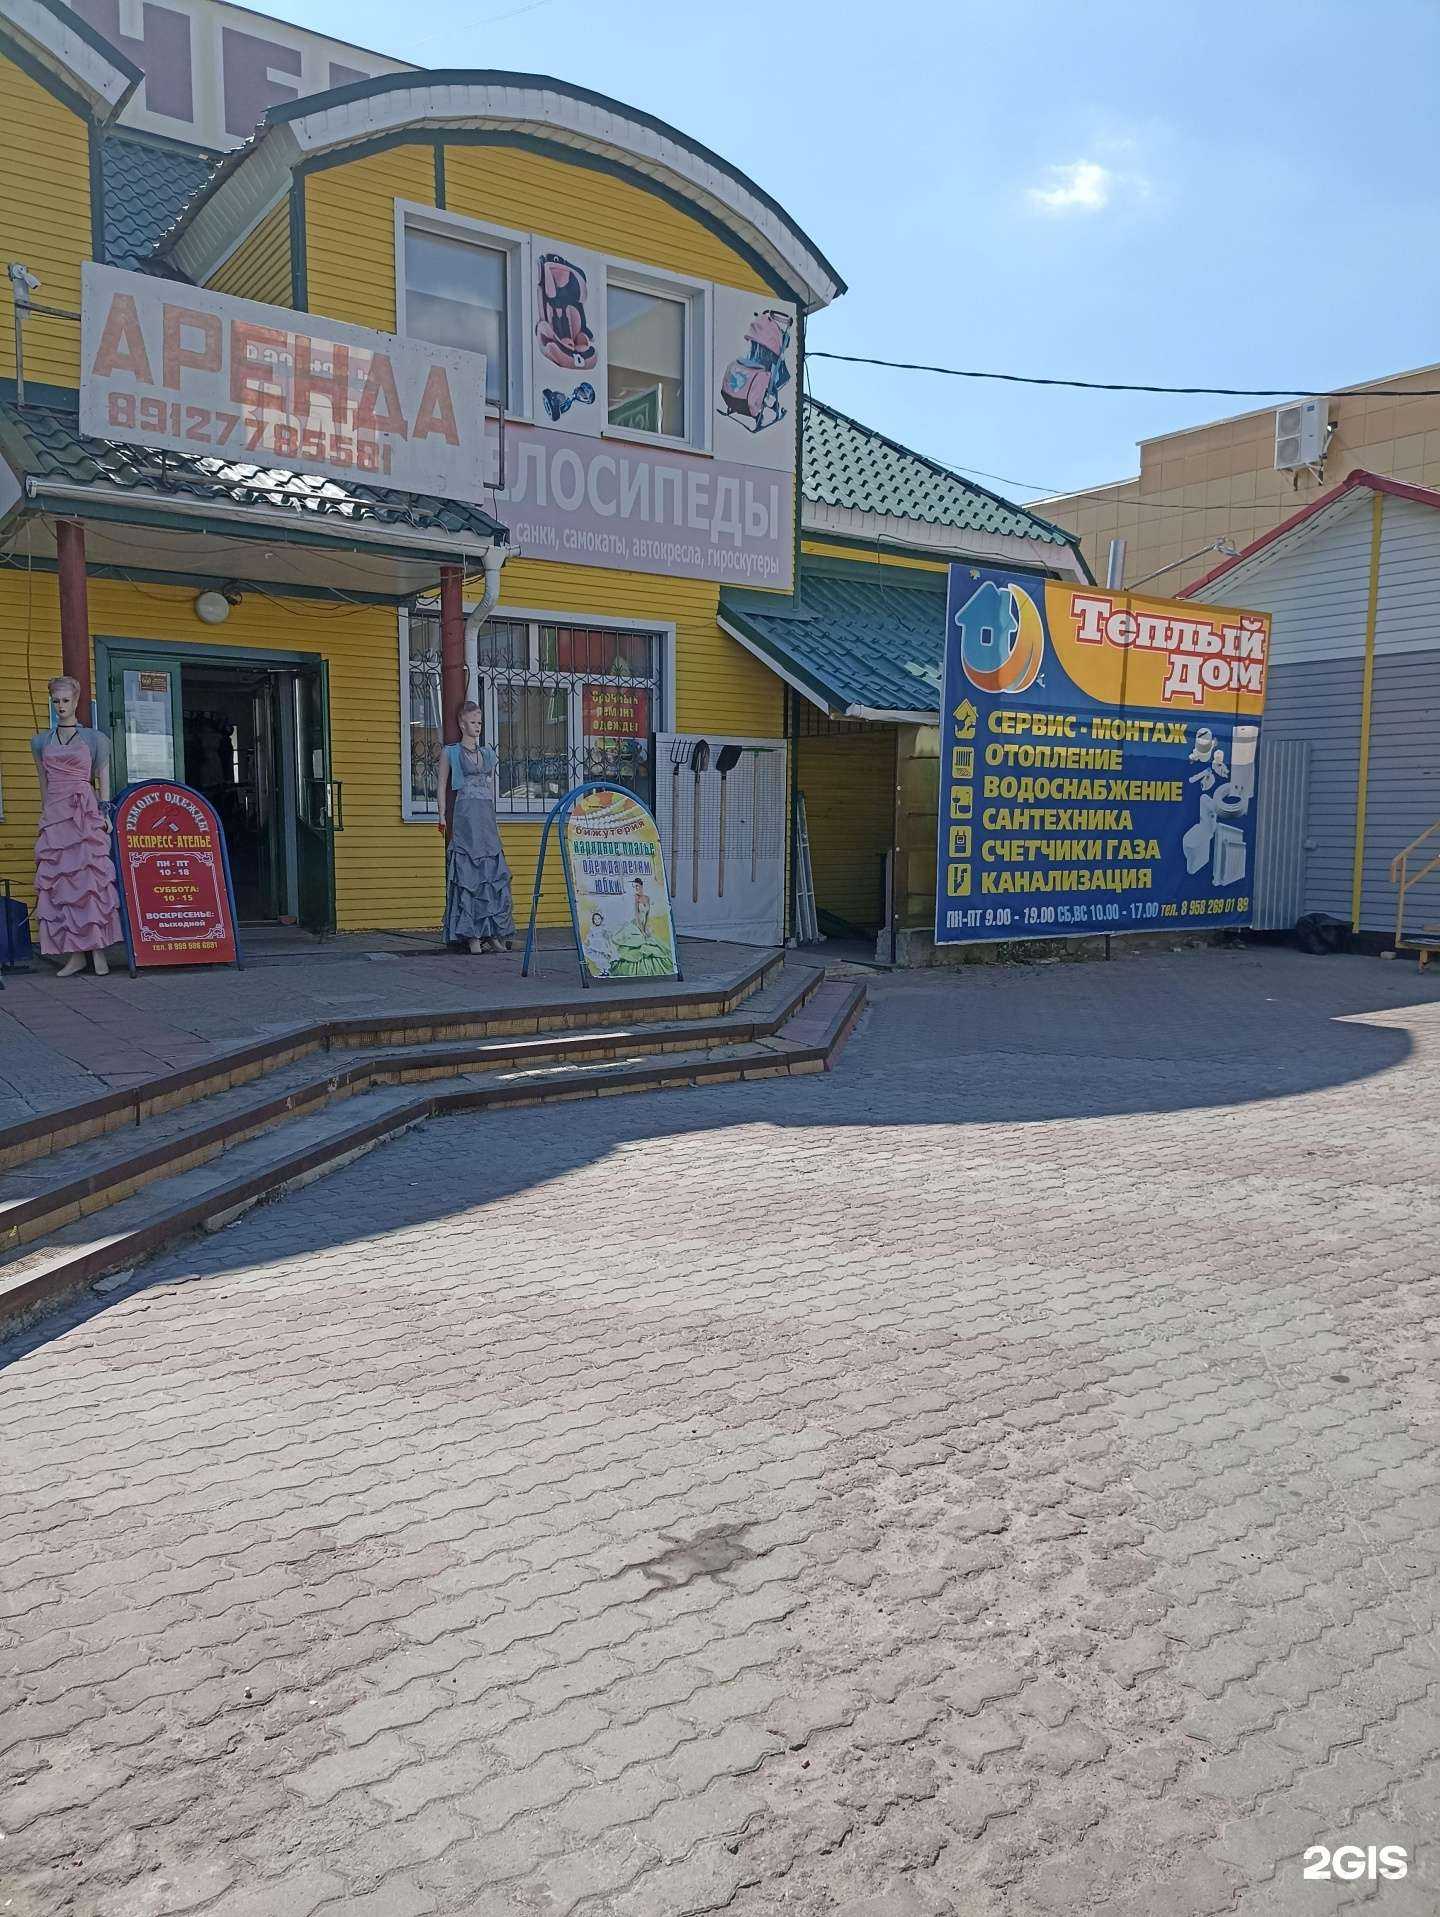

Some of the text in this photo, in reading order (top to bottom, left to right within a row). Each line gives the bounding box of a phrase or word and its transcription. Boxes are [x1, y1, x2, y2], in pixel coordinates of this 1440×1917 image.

[92, 292, 460, 447] АРЕНДА
[107, 391, 392, 476] 89127785581
[515, 522, 559, 552] санки,
[563, 527, 629, 560] самокаты,
[707, 547, 779, 578] гироскутеры
[987, 710, 1076, 739] СЕРВИС
[1091, 717, 1187, 745] МОНТАЖ
[985, 744, 1123, 771] ОТОПЛЕНИЕ
[983, 775, 1183, 803] ВОДОСНАБЖЕНИЕ
[126, 792, 210, 832] РЕМОНТ ОДЕЖДЫ
[982, 807, 1133, 832] САНТЕХНИКА
[126, 835, 212, 848] ЭКСПРЕСС-АТЕЛЬЕ
[575, 820, 645, 838] бижутерия
[981, 838, 1161, 863] СЧЕТЧИКИ ГАЗА
[980, 868, 1152, 895] КАНАЛИЗАЦИЯ
[158, 920, 206, 928] выходной
[946, 909, 981, 929] ПН-ПТ
[985, 908, 1011, 926] 9.00
[1024, 905, 1055, 924] 19.00
[1090, 903, 1119, 921] 10.00
[1130, 902, 1159, 919] 17.00
[1181, 900, 1188, 916] 8
[1225, 898, 1235, 913] 01
